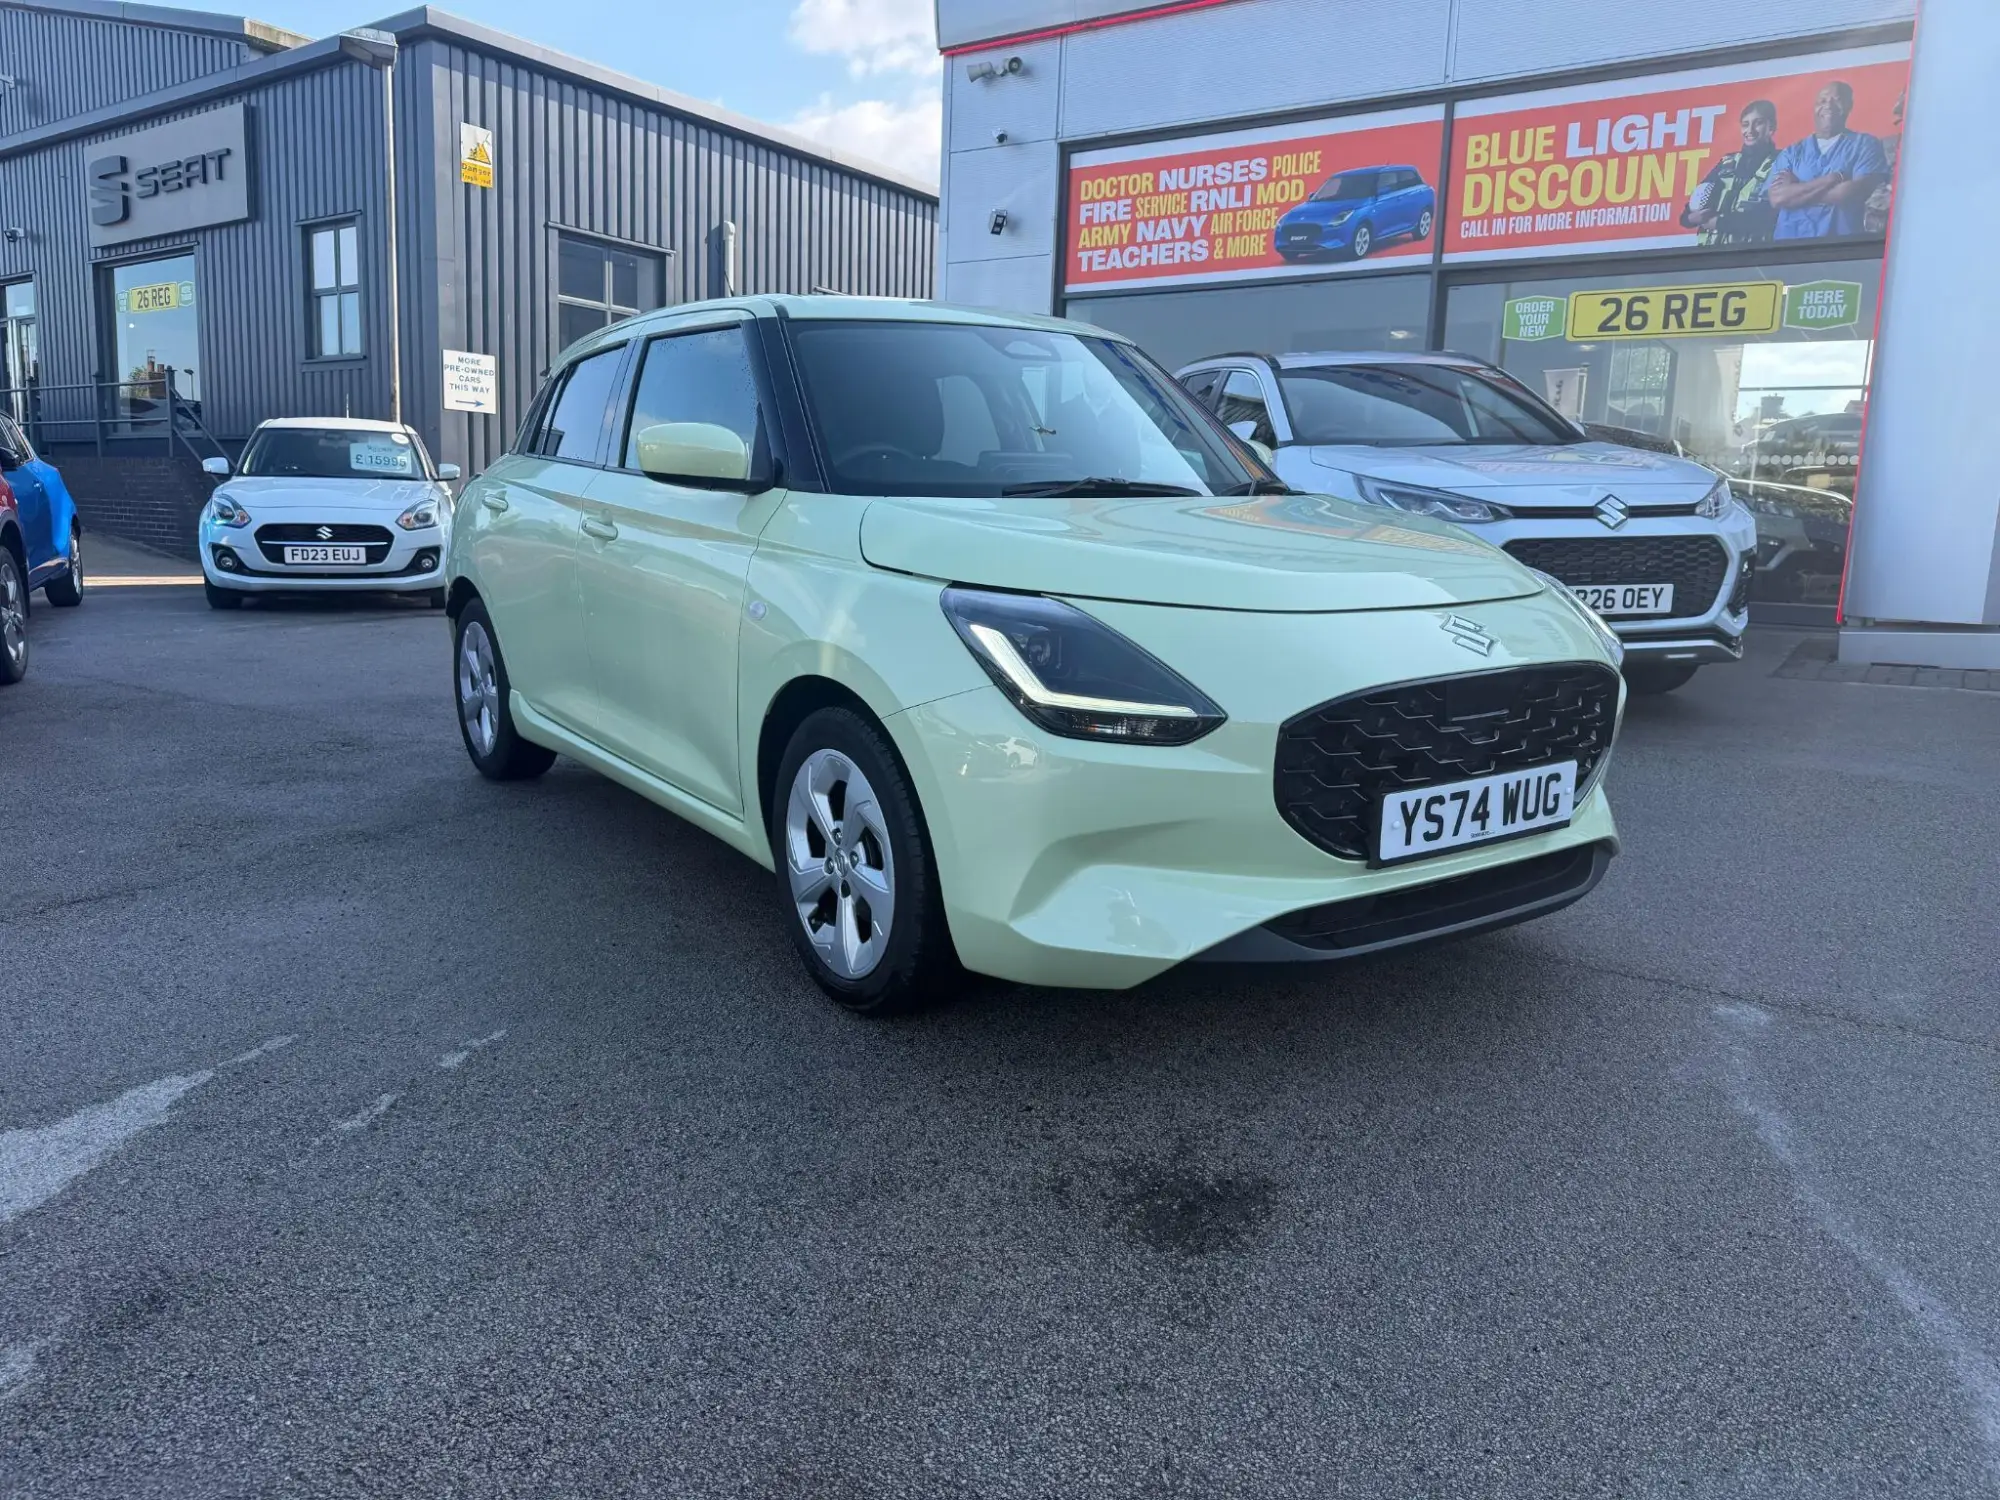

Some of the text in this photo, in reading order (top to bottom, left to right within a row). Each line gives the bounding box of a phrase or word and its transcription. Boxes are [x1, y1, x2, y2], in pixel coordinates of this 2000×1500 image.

[1466, 104, 1726, 170] BLUE LIGHT
[134, 148, 231, 199] SEAT
[1081, 151, 1322, 201] DOCTOR NURSES POLICE
[1462, 149, 1710, 217] DISCOUNT
[1080, 179, 1305, 225] FIRE SERVICE RNLI MOD
[1078, 207, 1279, 248] ARMY NAVY AIR FORCE
[1460, 202, 1671, 239] CALL IN FOR MORE INFORMATION
[1078, 233, 1267, 272] TEACHERS & MORE
[137, 290, 150, 309] 26
[152, 286, 171, 307] REG
[1515, 301, 1555, 314] ORDER
[1803, 289, 1845, 305] HERE
[1518, 313, 1550, 326] YOUR
[1597, 289, 1747, 333] 26 REG
[1797, 304, 1848, 320] TODAY
[1518, 325, 1547, 338] NEW
[444, 364, 495, 377] PRE-OWNED
[457, 356, 482, 366] MORE
[449, 382, 490, 394] THIS WAY
[458, 374, 482, 384] CARS
[291, 549, 361, 561] FD23 EUJ
[1622, 586, 1665, 609] OEY
[1400, 772, 1562, 846] YS74 WUG
